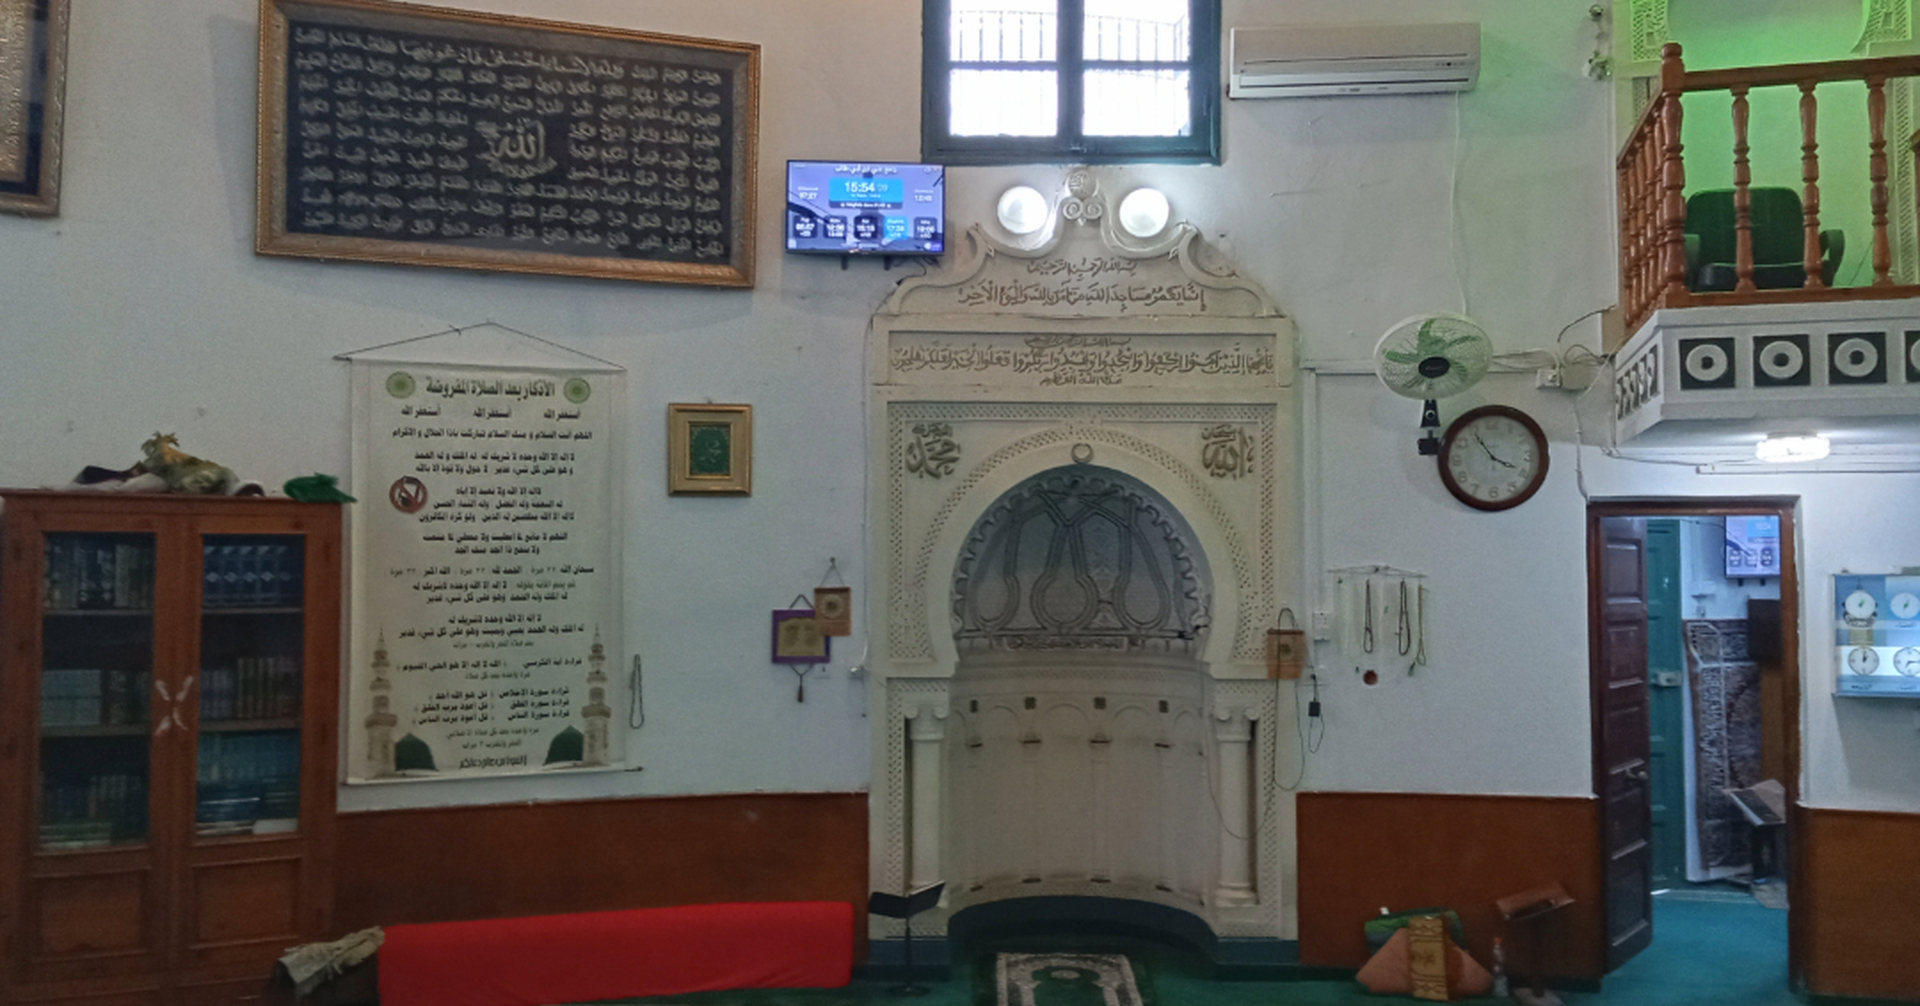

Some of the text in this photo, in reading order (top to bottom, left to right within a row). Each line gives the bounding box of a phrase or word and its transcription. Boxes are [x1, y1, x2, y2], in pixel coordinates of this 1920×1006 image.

[844, 181, 876, 193] 15:54
[504, 384, 523, 401] بعد
[1471, 483, 1480, 496] 7
[1488, 486, 1499, 499] 6
